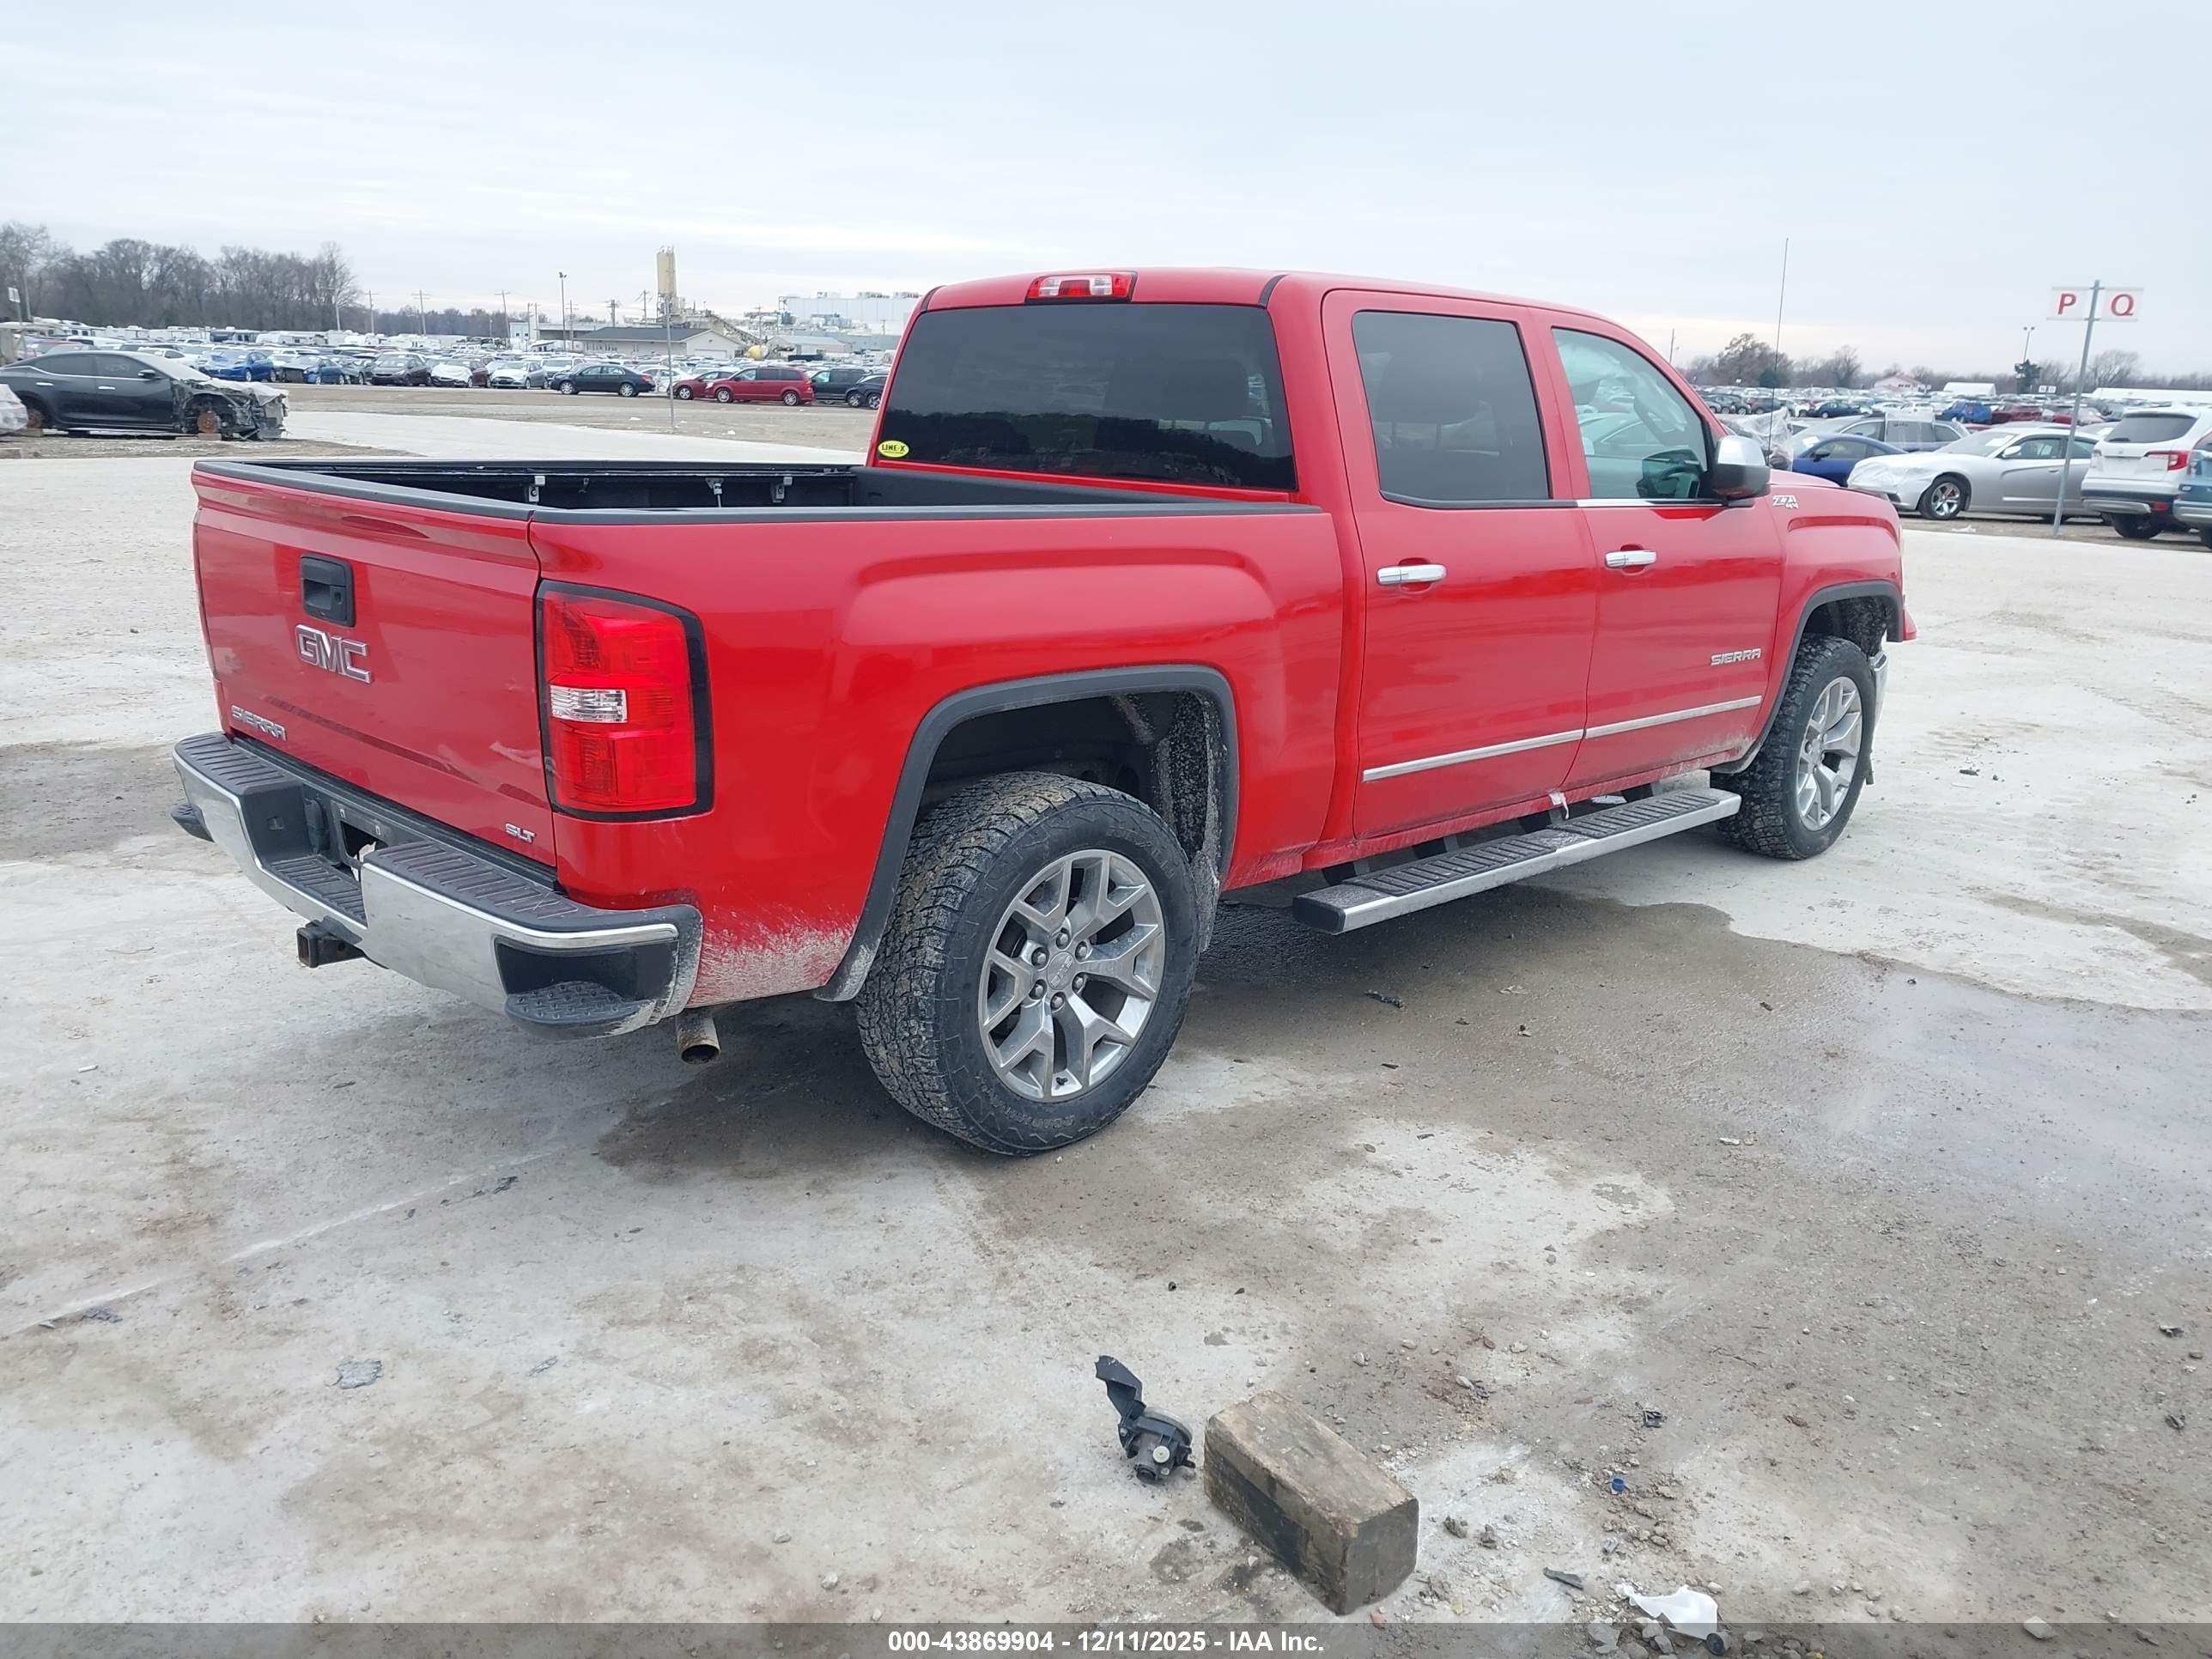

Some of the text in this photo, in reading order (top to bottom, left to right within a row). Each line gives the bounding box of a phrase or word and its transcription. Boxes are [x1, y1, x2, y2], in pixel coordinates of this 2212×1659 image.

[2057, 293, 2077, 315] P
[2111, 293, 2135, 317] Q
[295, 623, 372, 684] GMC
[1710, 647, 1762, 666] SIERRA
[231, 704, 287, 742] SIERRA
[505, 823, 536, 843] SLT
